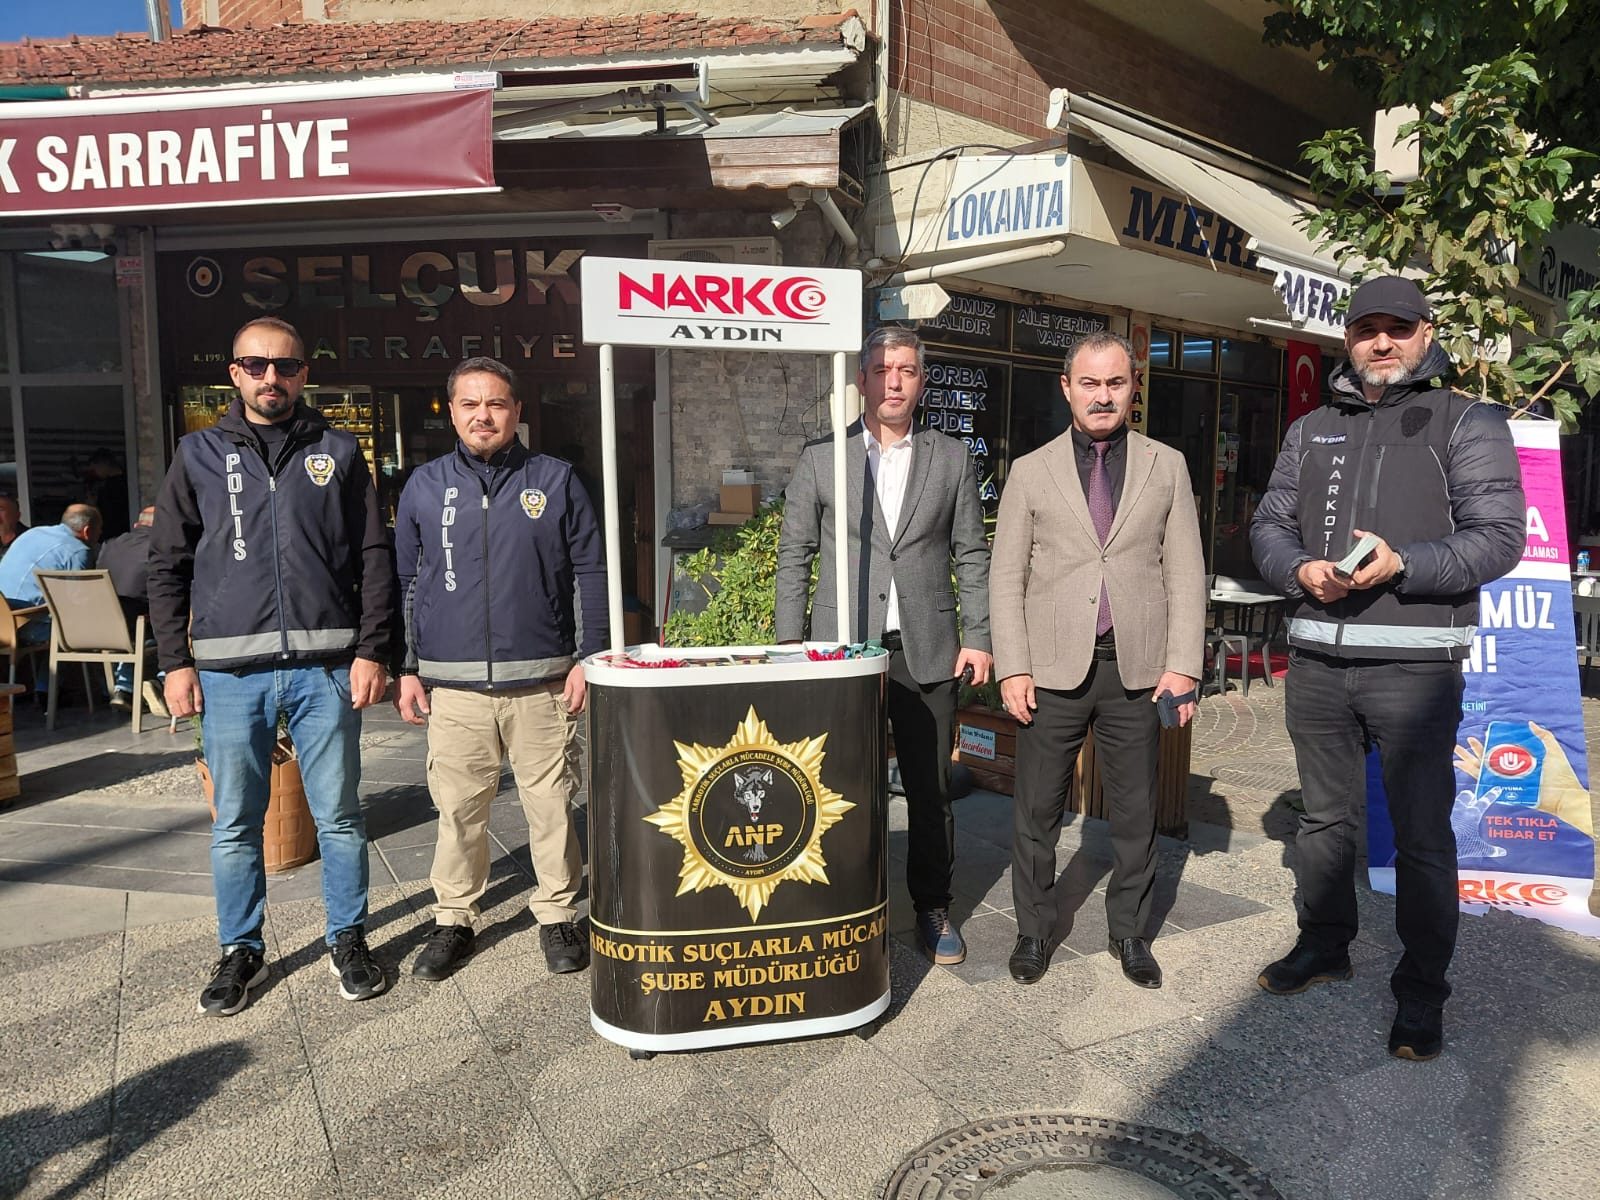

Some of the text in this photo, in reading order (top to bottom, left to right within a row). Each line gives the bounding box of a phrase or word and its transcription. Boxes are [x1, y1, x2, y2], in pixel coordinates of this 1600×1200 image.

[36, 108, 350, 194] SARRAFİYE
[946, 179, 1064, 241] LOKANTA
[1122, 186, 1263, 271] MER
[241, 249, 587, 322] SELÇUK
[311, 325, 577, 360] ARRAFİYE
[670, 325, 783, 342] AYDIN
[1037, 329, 1078, 348] VARD
[926, 409, 974, 433] PİDE
[1311, 434, 1346, 444] AYDIN
[1323, 455, 1346, 557] NARKOTİ
[1480, 584, 1556, 630] MÜZ
[740, 751, 776, 763] MÜCADELE
[724, 823, 784, 848] ANP
[1486, 816, 1558, 828] TEK TIKLA
[1488, 827, 1557, 841] İHBAR ET
[1458, 879, 1569, 906] RKO
[683, 934, 815, 968] SUÇLARLA
[640, 949, 861, 996] ŞUBE MÜDÜRLÜĞÜ
[702, 992, 807, 1023] AYDIN
